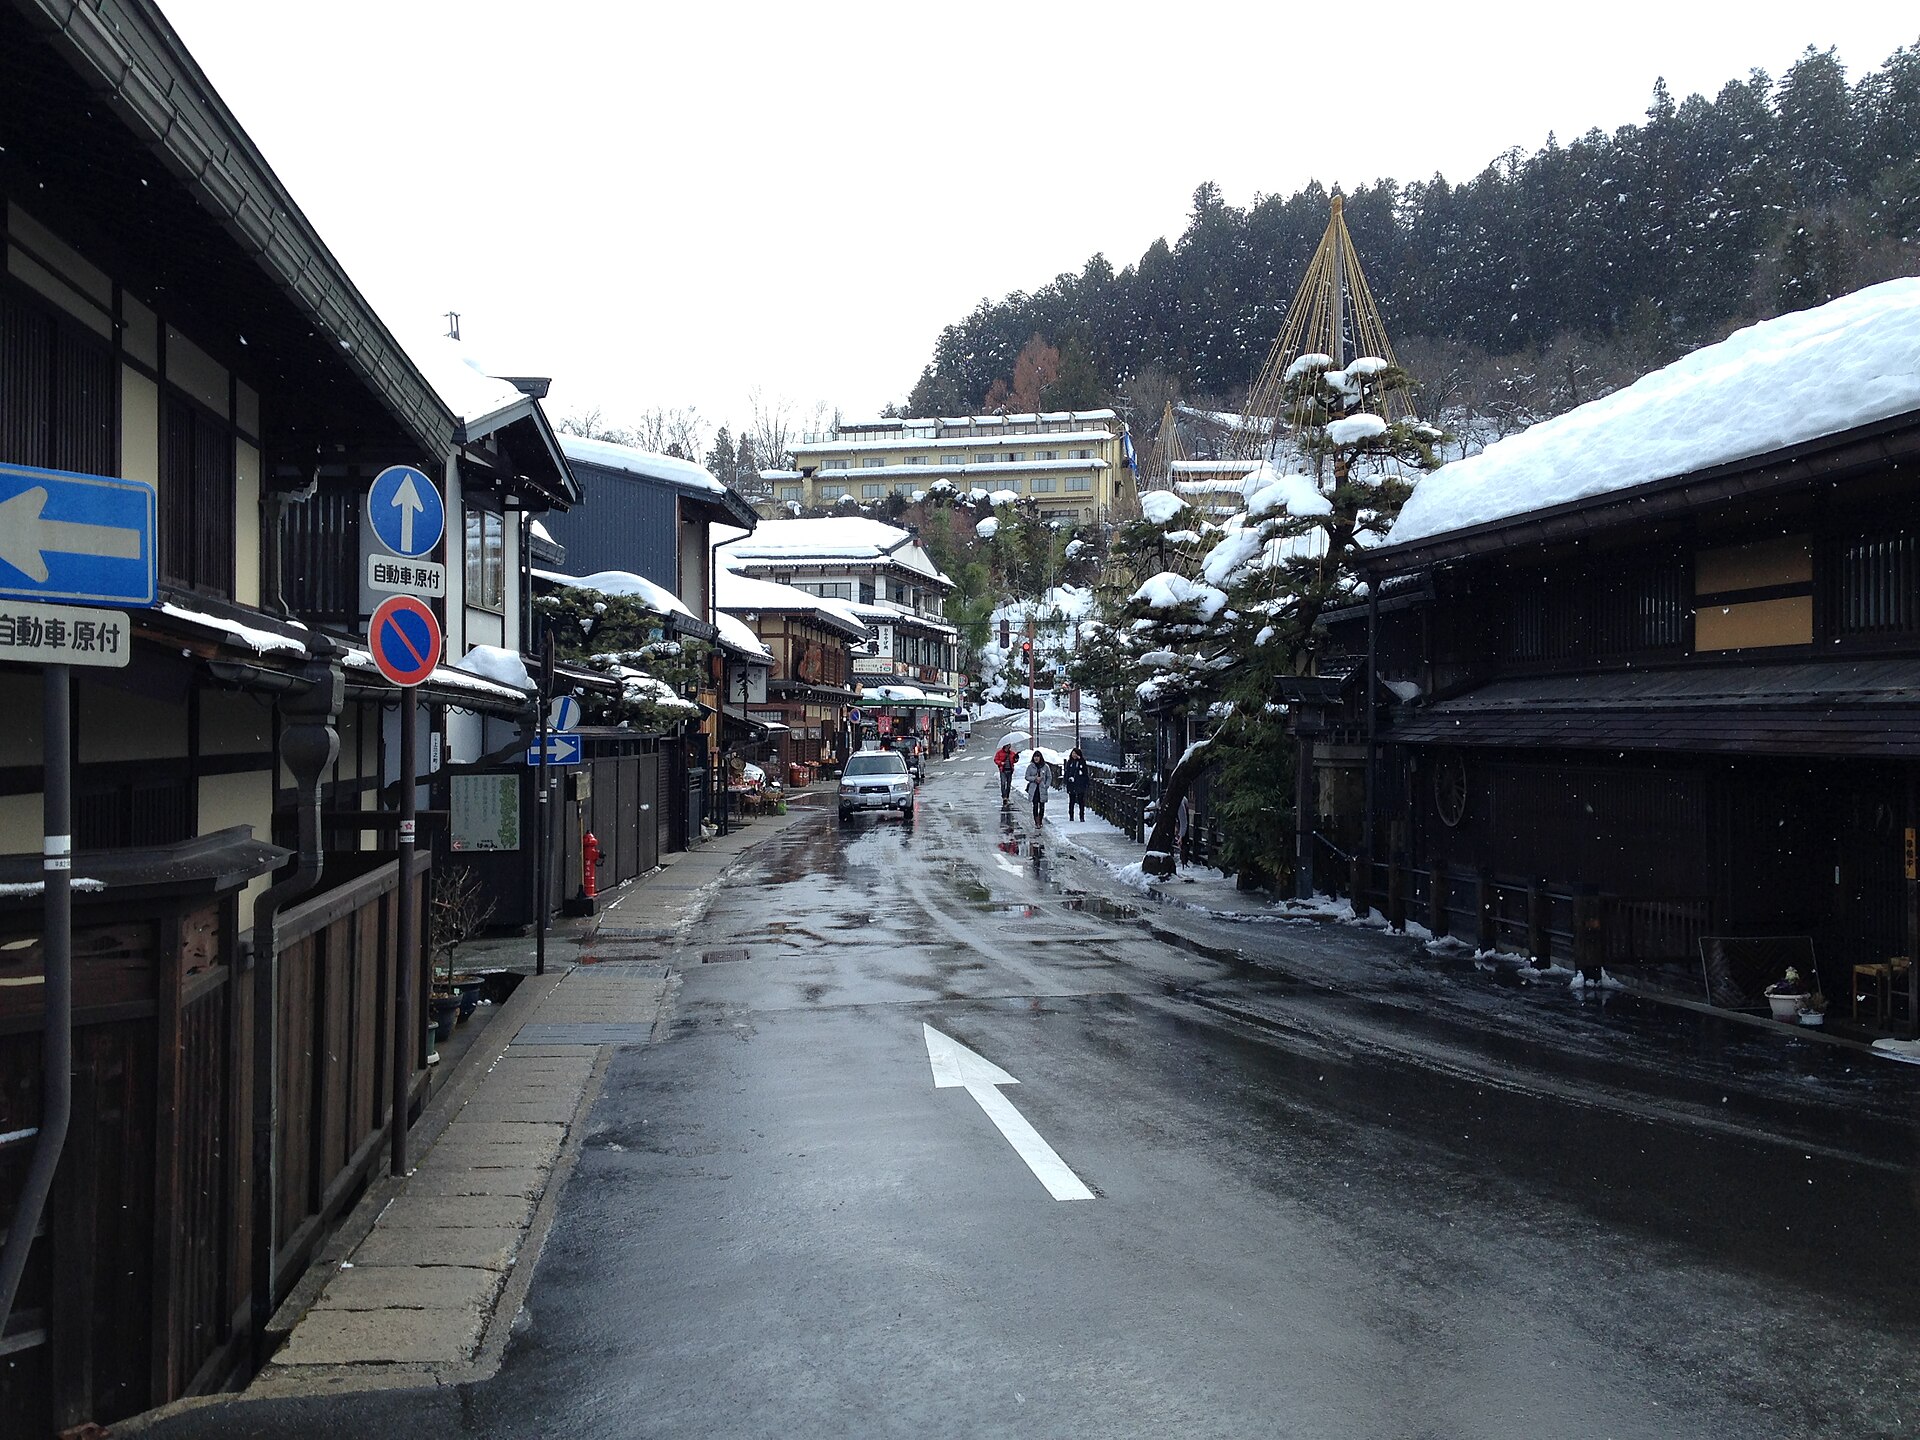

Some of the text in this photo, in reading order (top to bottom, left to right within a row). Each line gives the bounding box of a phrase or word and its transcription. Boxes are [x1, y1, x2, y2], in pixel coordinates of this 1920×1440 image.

[374, 562, 440, 590] 自動車・原付
[1058, 666, 1065, 674] P
